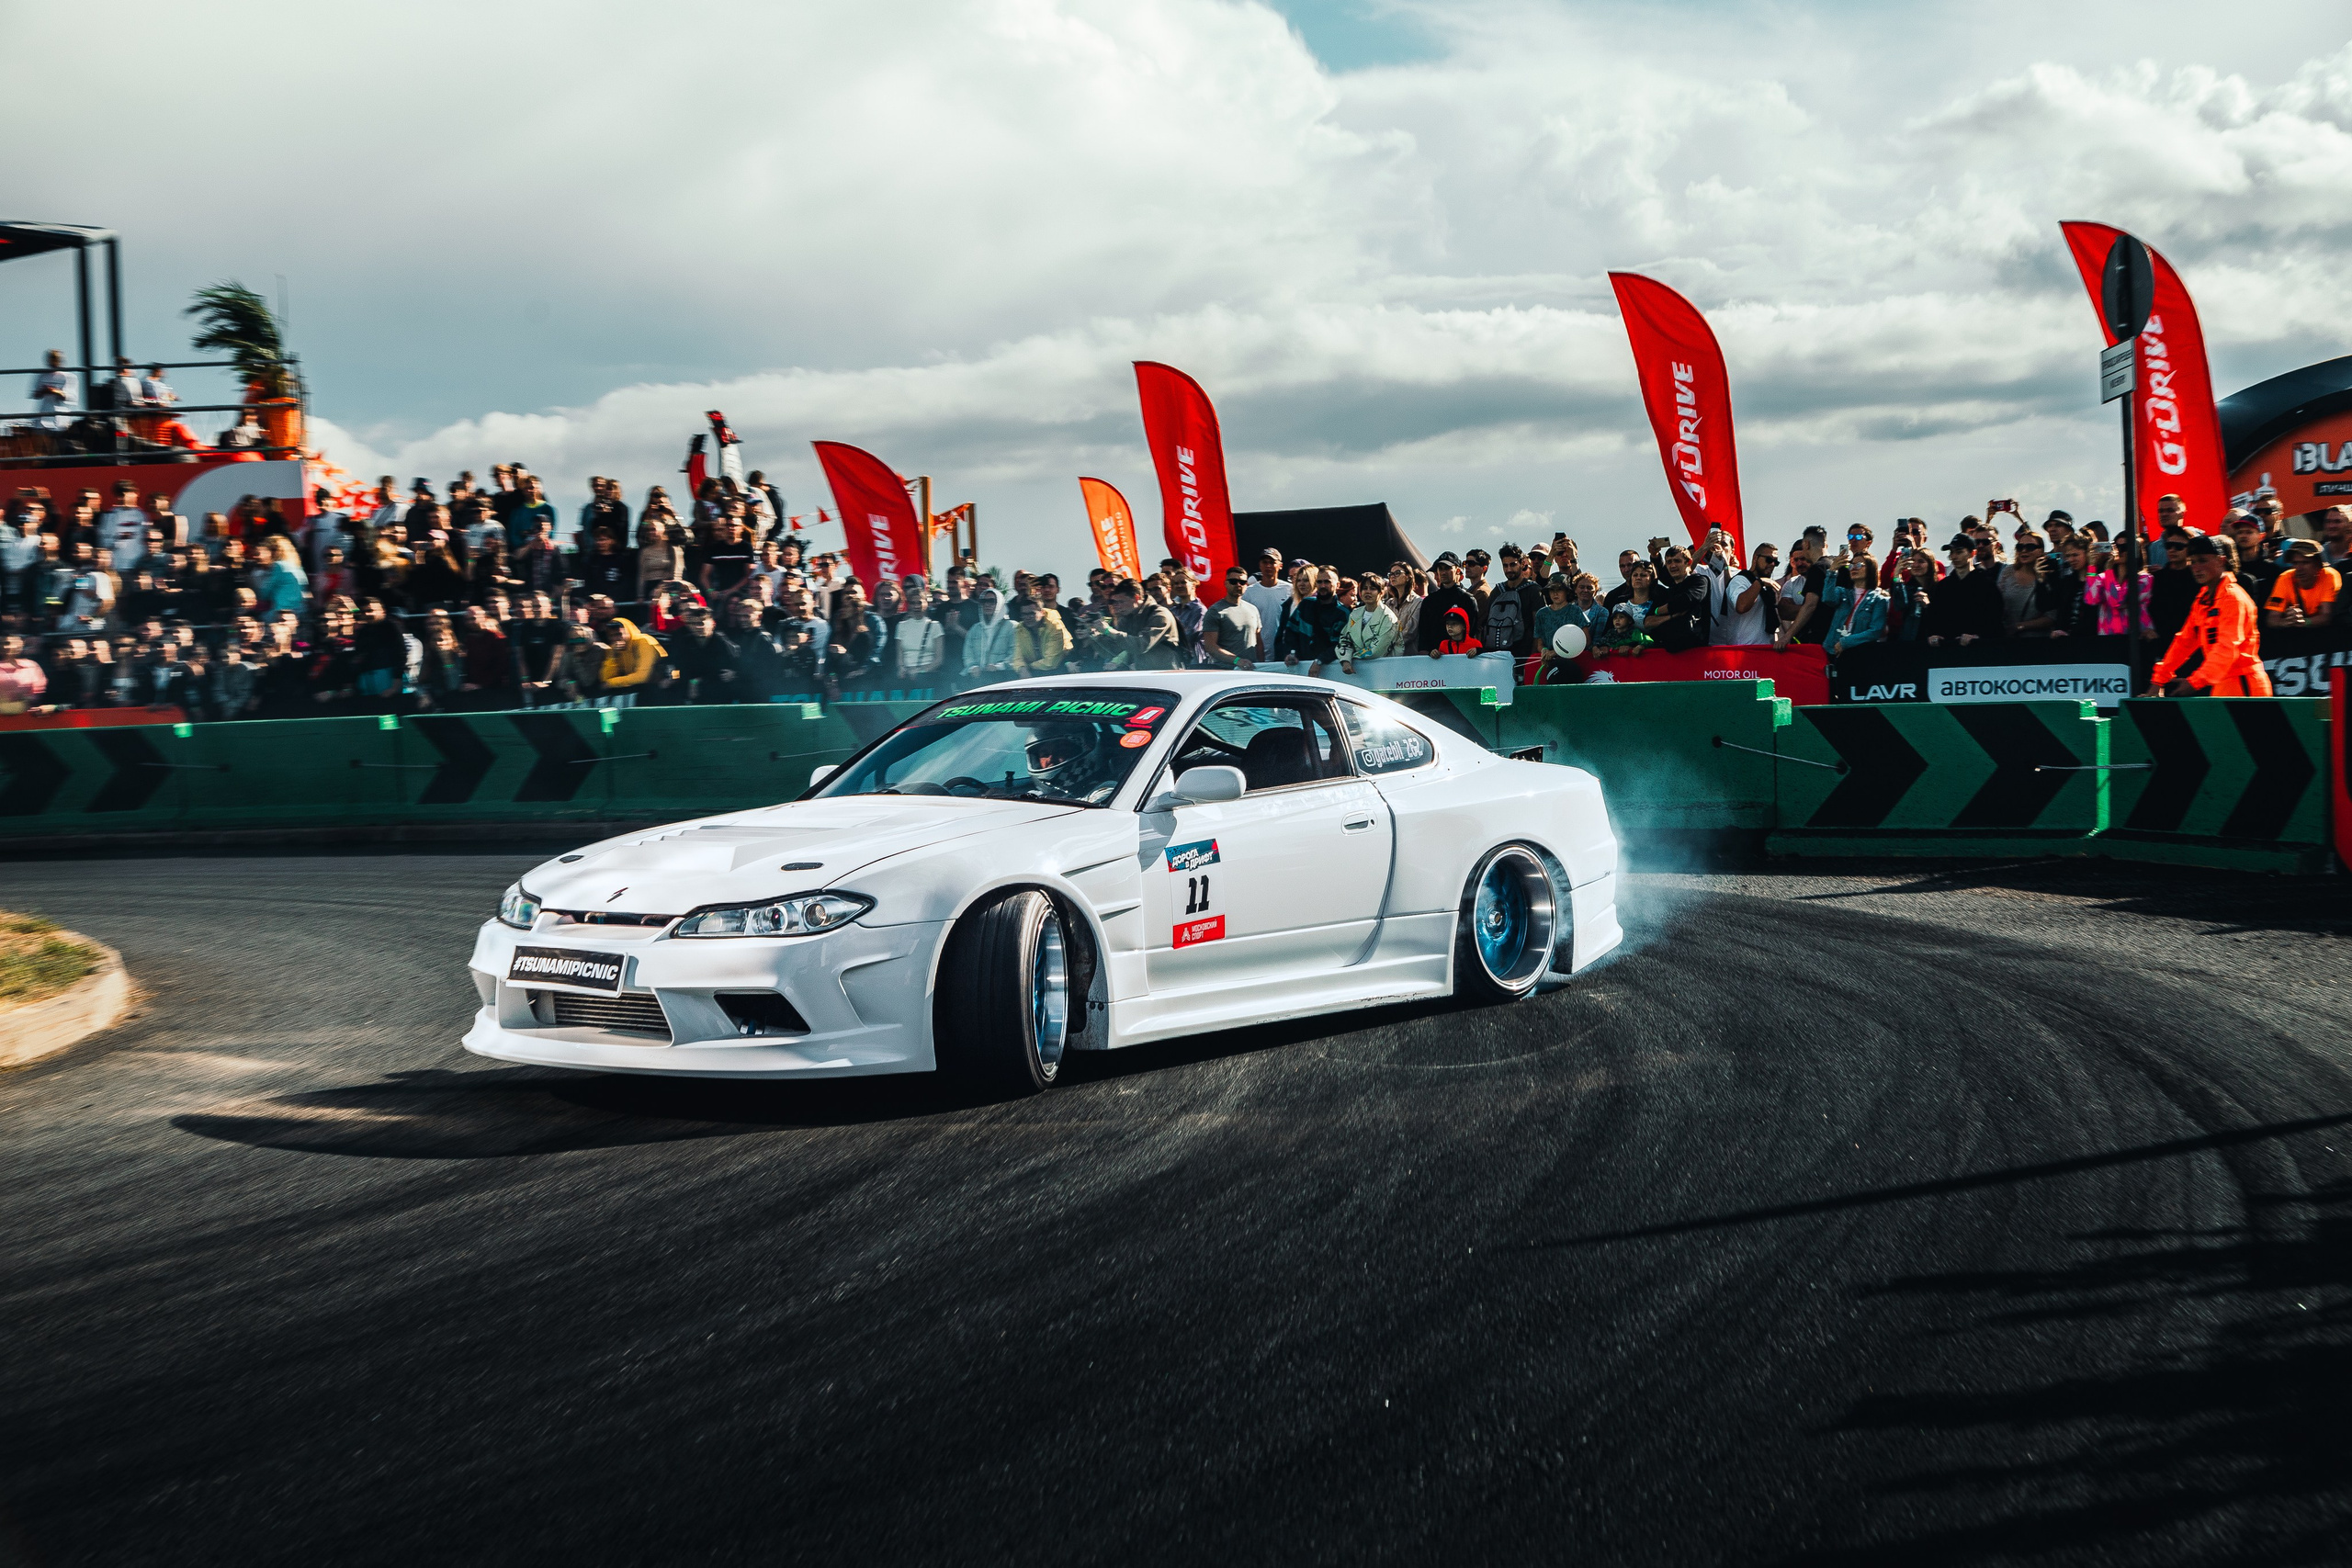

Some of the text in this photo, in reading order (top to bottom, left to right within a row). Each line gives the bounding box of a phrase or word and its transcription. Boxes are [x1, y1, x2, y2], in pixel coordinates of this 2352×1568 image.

[867, 513, 900, 581] RIVE
[1396, 679, 1447, 689] MOTOR OIL
[1704, 670, 1760, 680] MOTOR OIL
[1850, 683, 1917, 701] LAVR
[1940, 676, 2128, 696] автокосметика
[936, 701, 1137, 719] TSUNAMI PICNIC
[1172, 849, 1199, 868] ДОРОГА
[1189, 851, 1214, 871] ДРИФТ
[1185, 874, 1210, 916] 11
[513, 956, 619, 981] #TSUNAMIPICNIC
